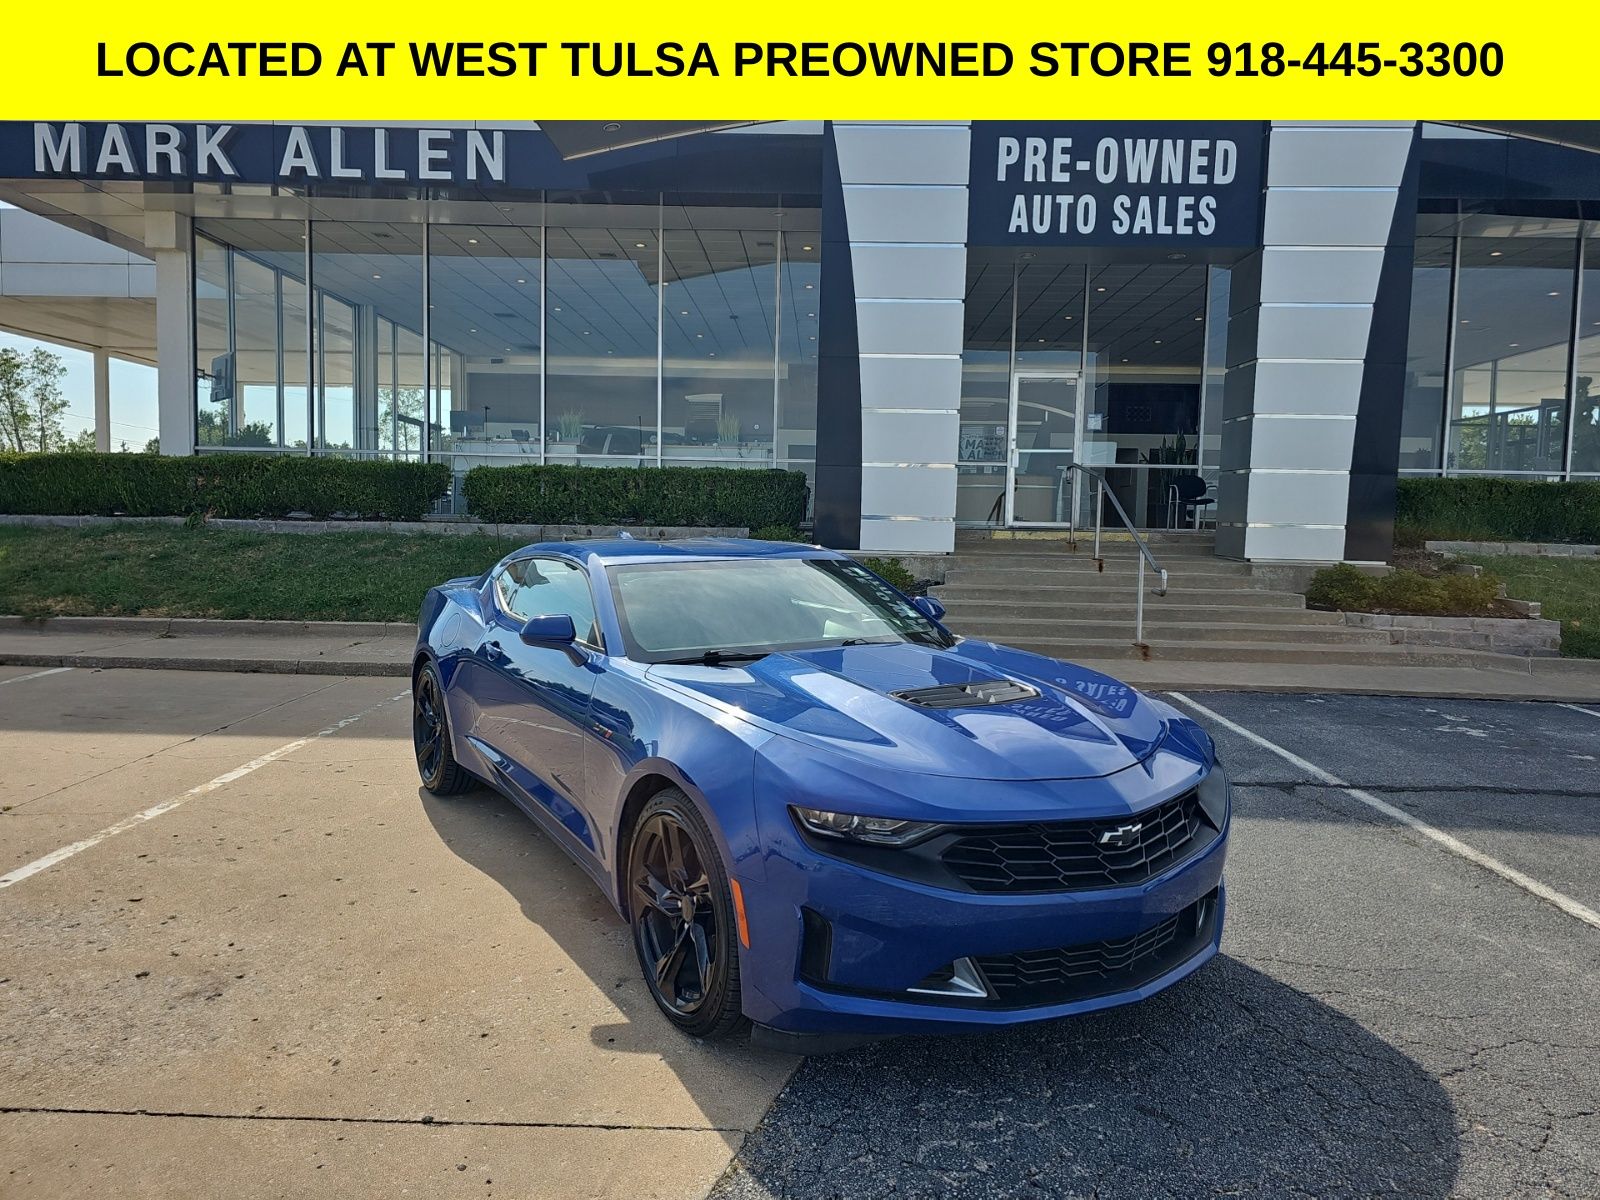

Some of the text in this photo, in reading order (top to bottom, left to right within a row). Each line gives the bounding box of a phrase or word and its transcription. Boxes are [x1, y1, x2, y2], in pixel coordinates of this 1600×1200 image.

[34, 122, 506, 181] MARK ALLEN
[997, 137, 1237, 184] PRE-OWNED
[1008, 194, 1217, 236] AUTO SALES
